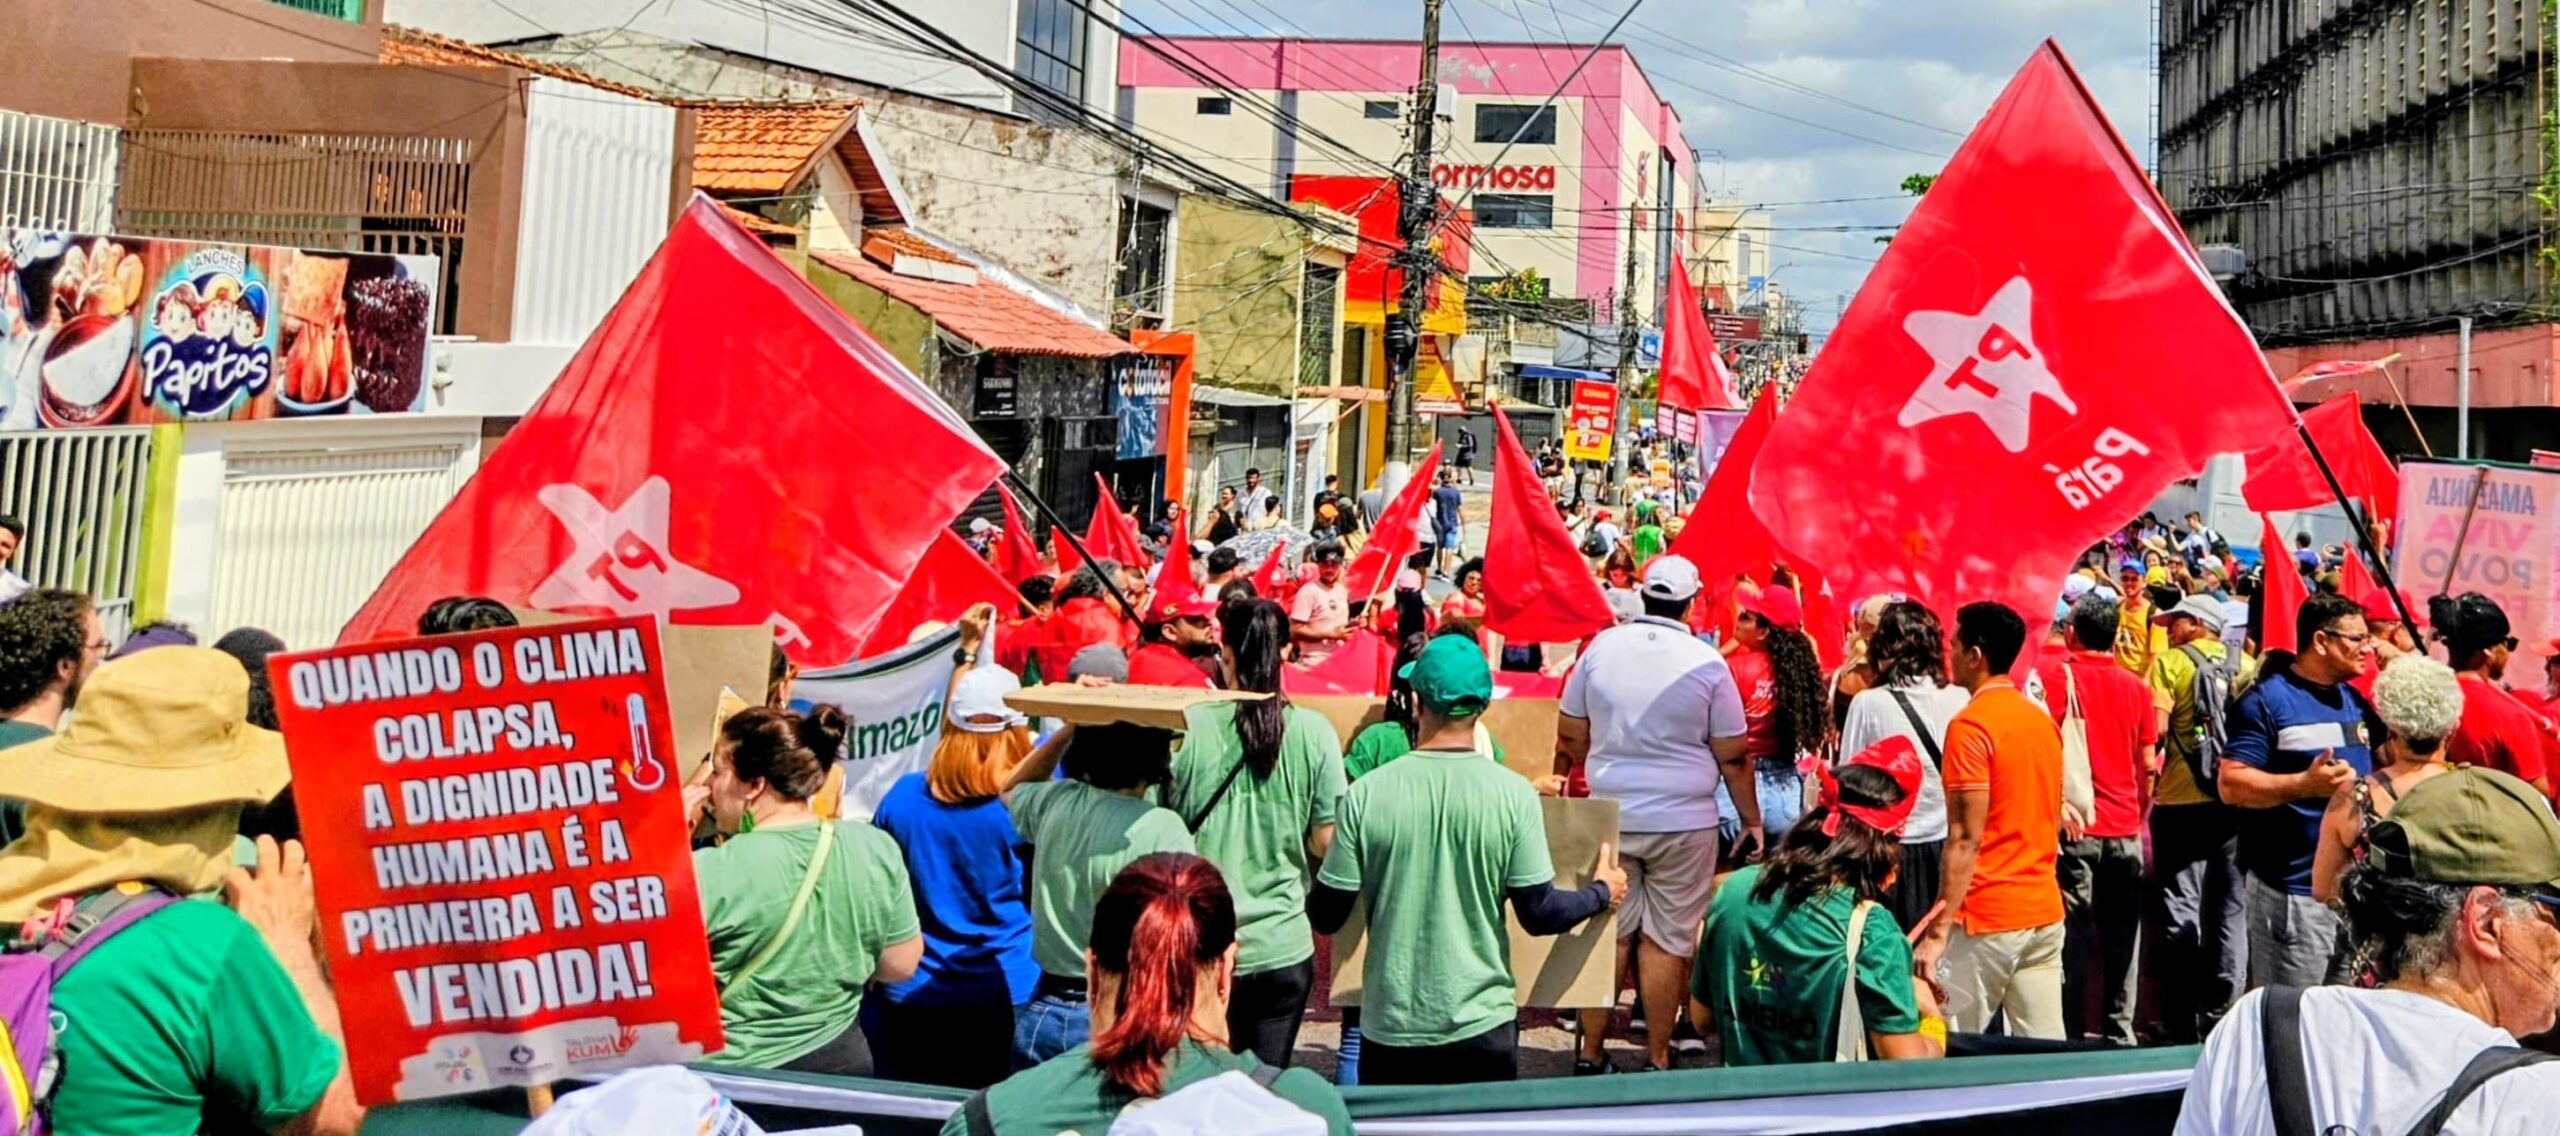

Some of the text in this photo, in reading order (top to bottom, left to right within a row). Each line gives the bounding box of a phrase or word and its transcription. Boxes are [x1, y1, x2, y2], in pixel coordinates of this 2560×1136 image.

[1430, 163, 1554, 189] ormosa
[186, 250, 246, 274] LANCHES
[289, 627, 647, 711] QUANDO O CLIMA
[373, 699, 575, 765] COLAPSA,
[847, 702, 942, 760] imazo
[363, 757, 619, 829] A DIGNIDADE
[371, 813, 631, 889] HUMANA É A
[342, 874, 668, 955] PRIMEIRA A SER
[393, 939, 655, 1028] VENDIDA!
